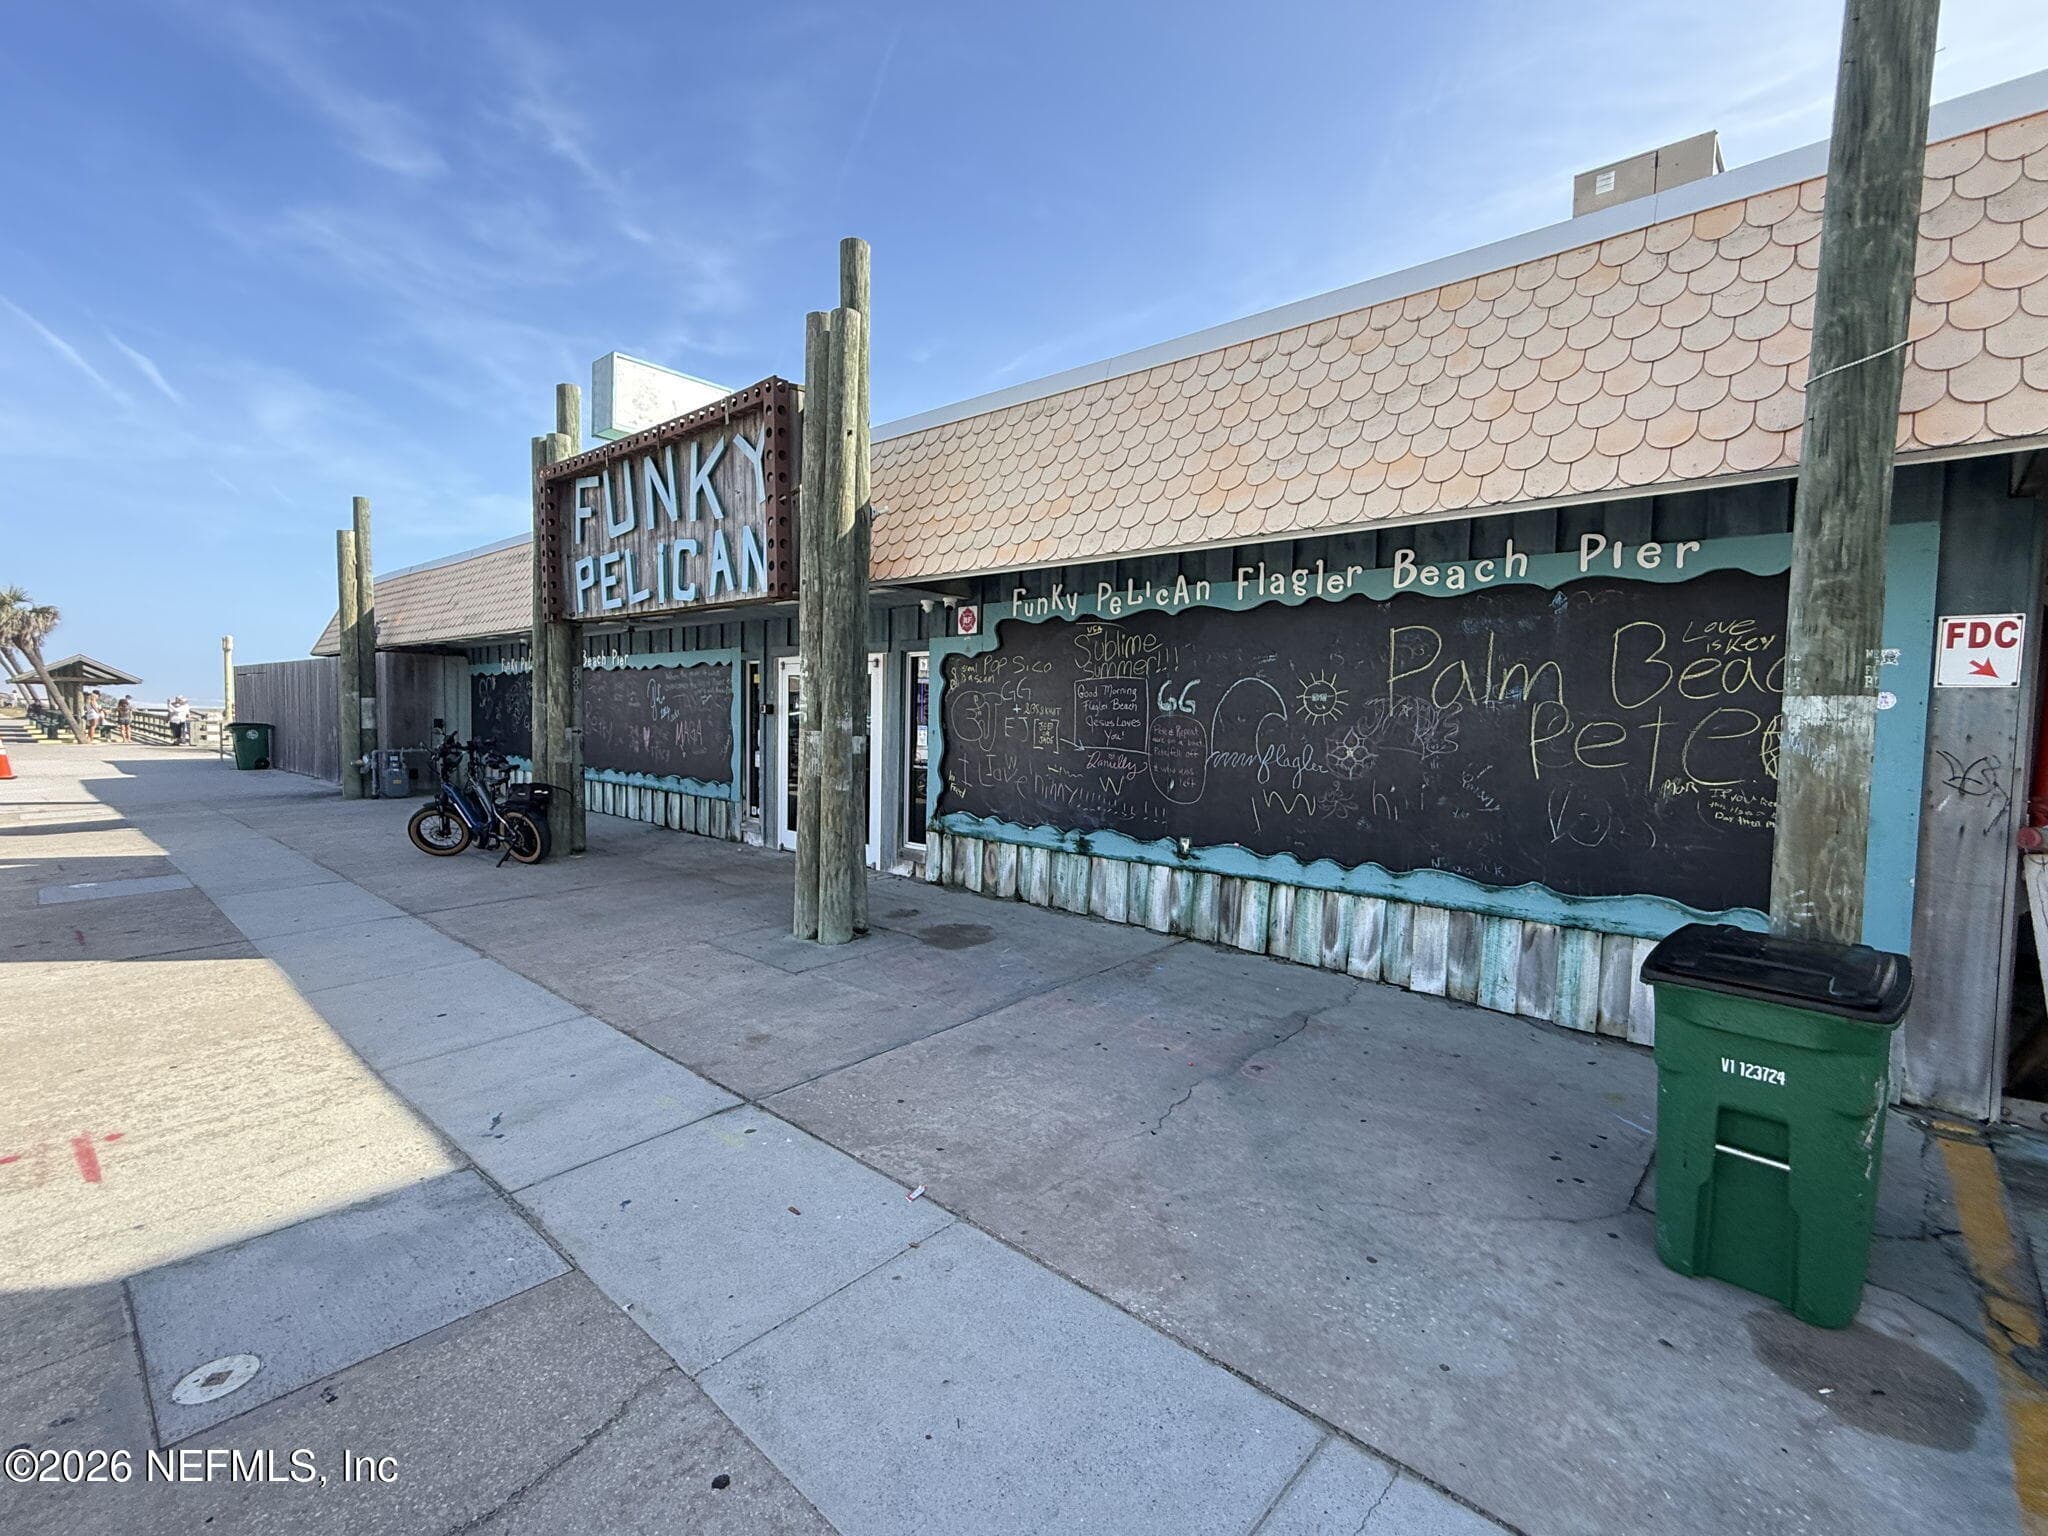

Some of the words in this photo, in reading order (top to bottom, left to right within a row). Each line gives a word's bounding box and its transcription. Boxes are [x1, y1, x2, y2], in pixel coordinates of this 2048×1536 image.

[574, 426, 766, 545] FUNKY
[574, 525, 769, 615] PELICAN
[1237, 558, 1363, 601] Flagler
[1392, 539, 1528, 589] Beach
[1074, 630, 1163, 669] Sublime
[1682, 619, 1758, 643] Love
[1946, 620, 2019, 650] FDC
[1386, 625, 1563, 717] Palm
[1612, 622, 1786, 709] Beac
[1739, 1061, 1786, 1086] 123724
